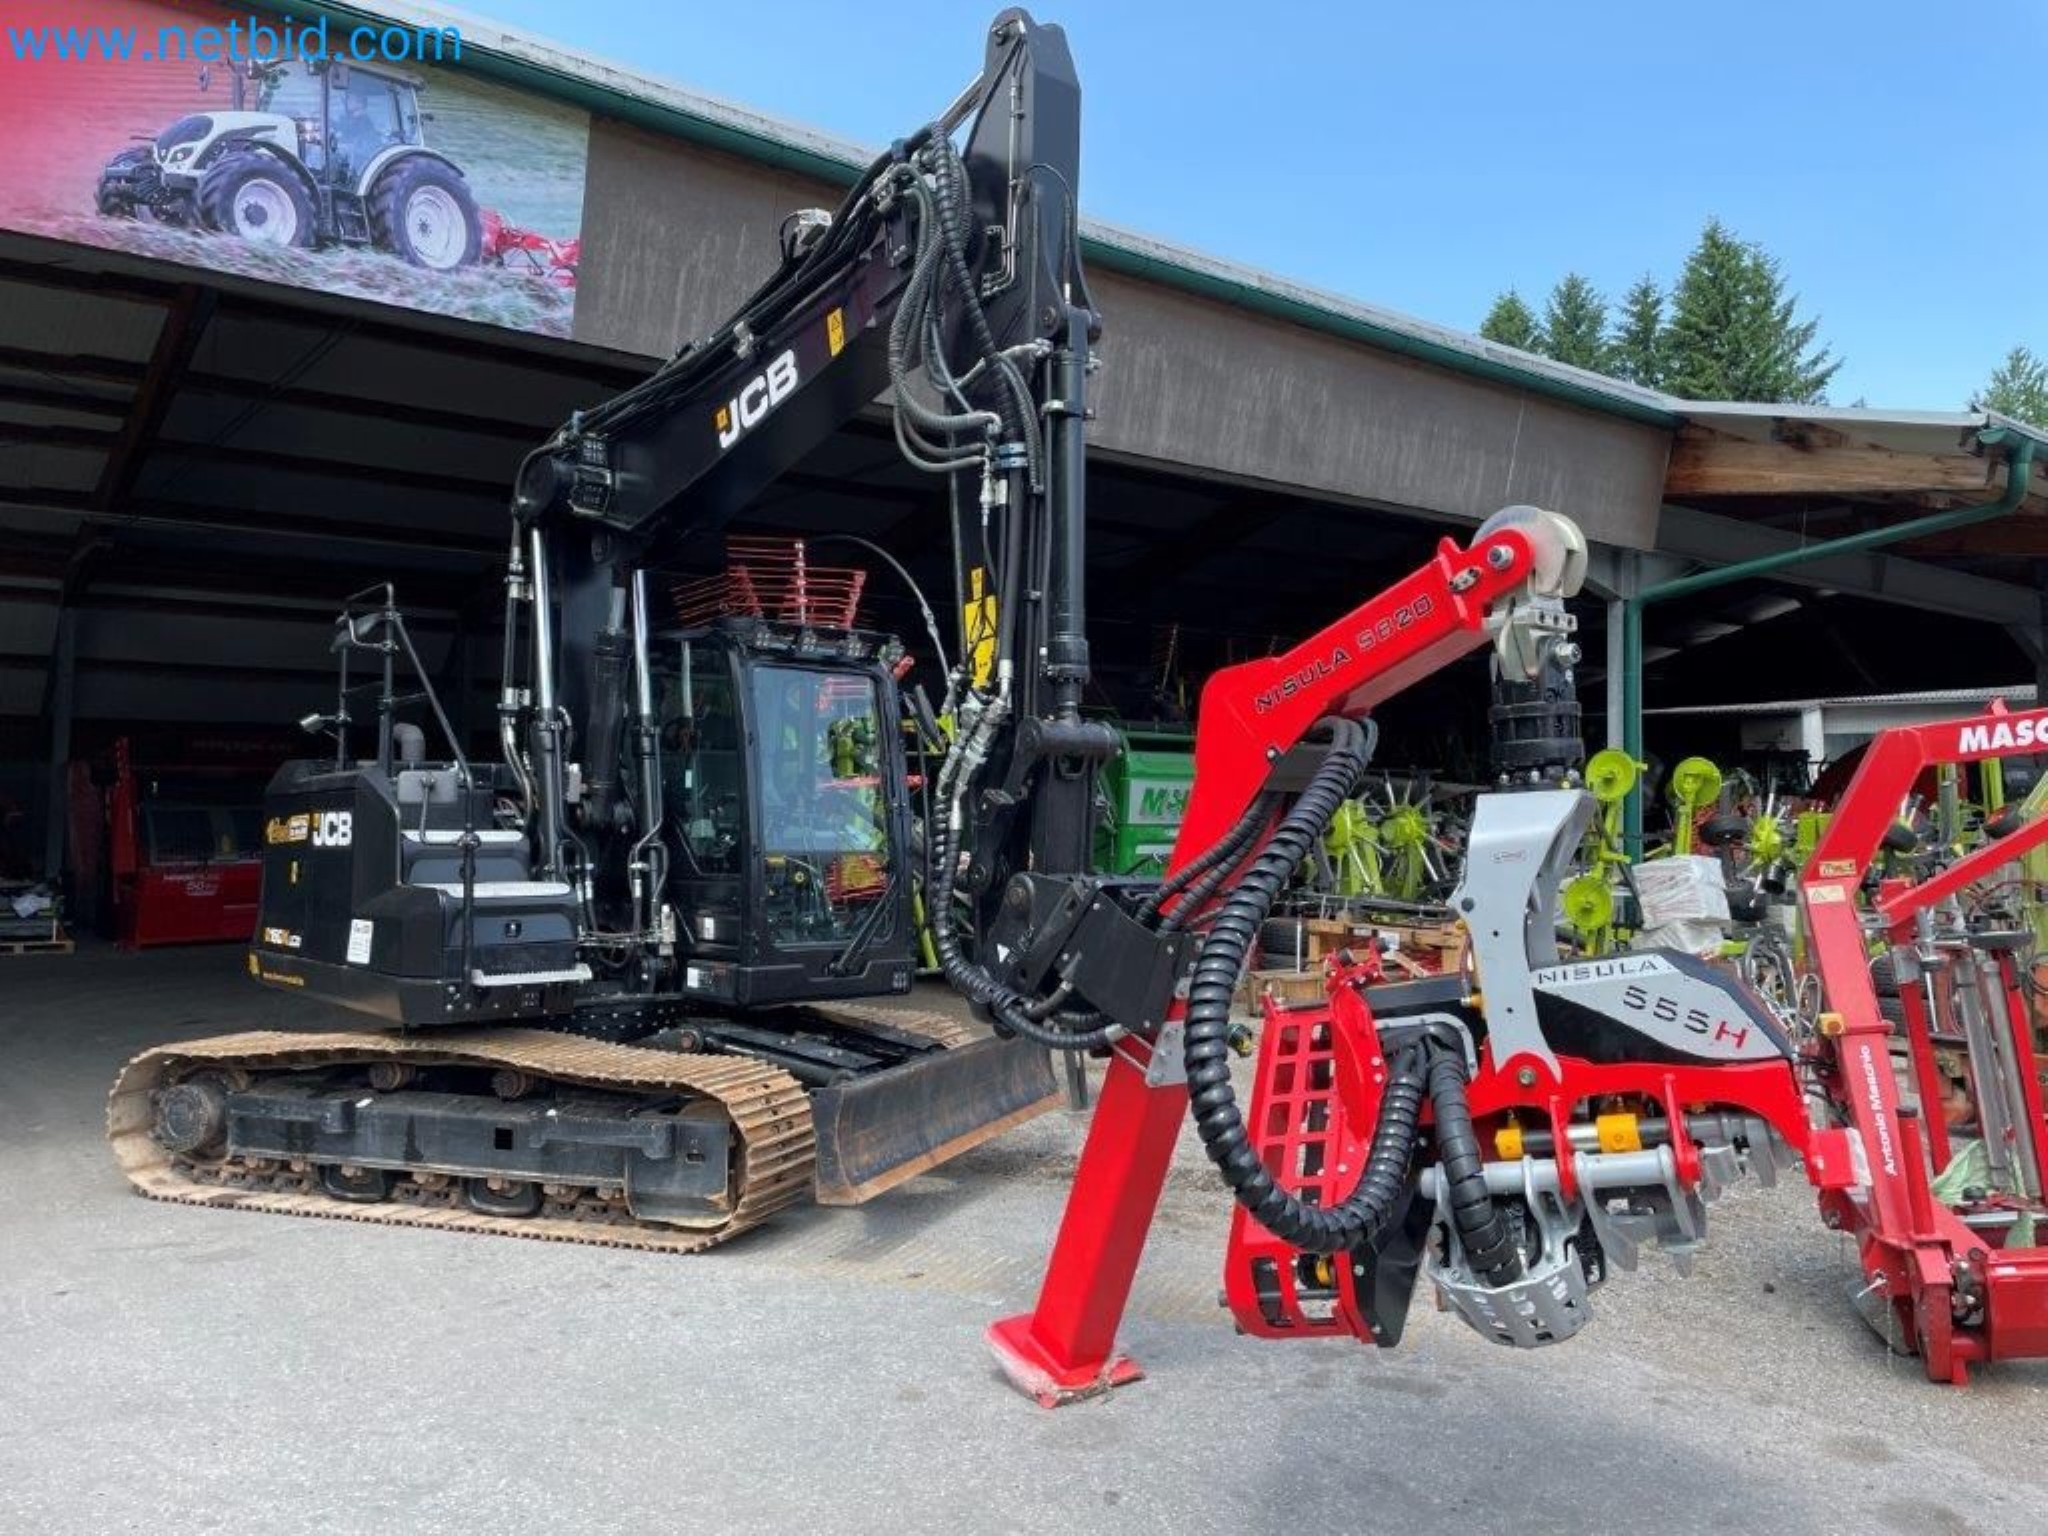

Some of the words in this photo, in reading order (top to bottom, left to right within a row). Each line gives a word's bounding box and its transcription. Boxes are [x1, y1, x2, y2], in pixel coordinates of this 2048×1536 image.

[717, 349, 799, 449] JCB
[1256, 647, 1351, 714] NISULA
[311, 811, 353, 847] JCB
[1537, 958, 1660, 985] NISULA
[1860, 1044, 1884, 1112] Maschio
[1873, 1112, 1899, 1177] Antonio
